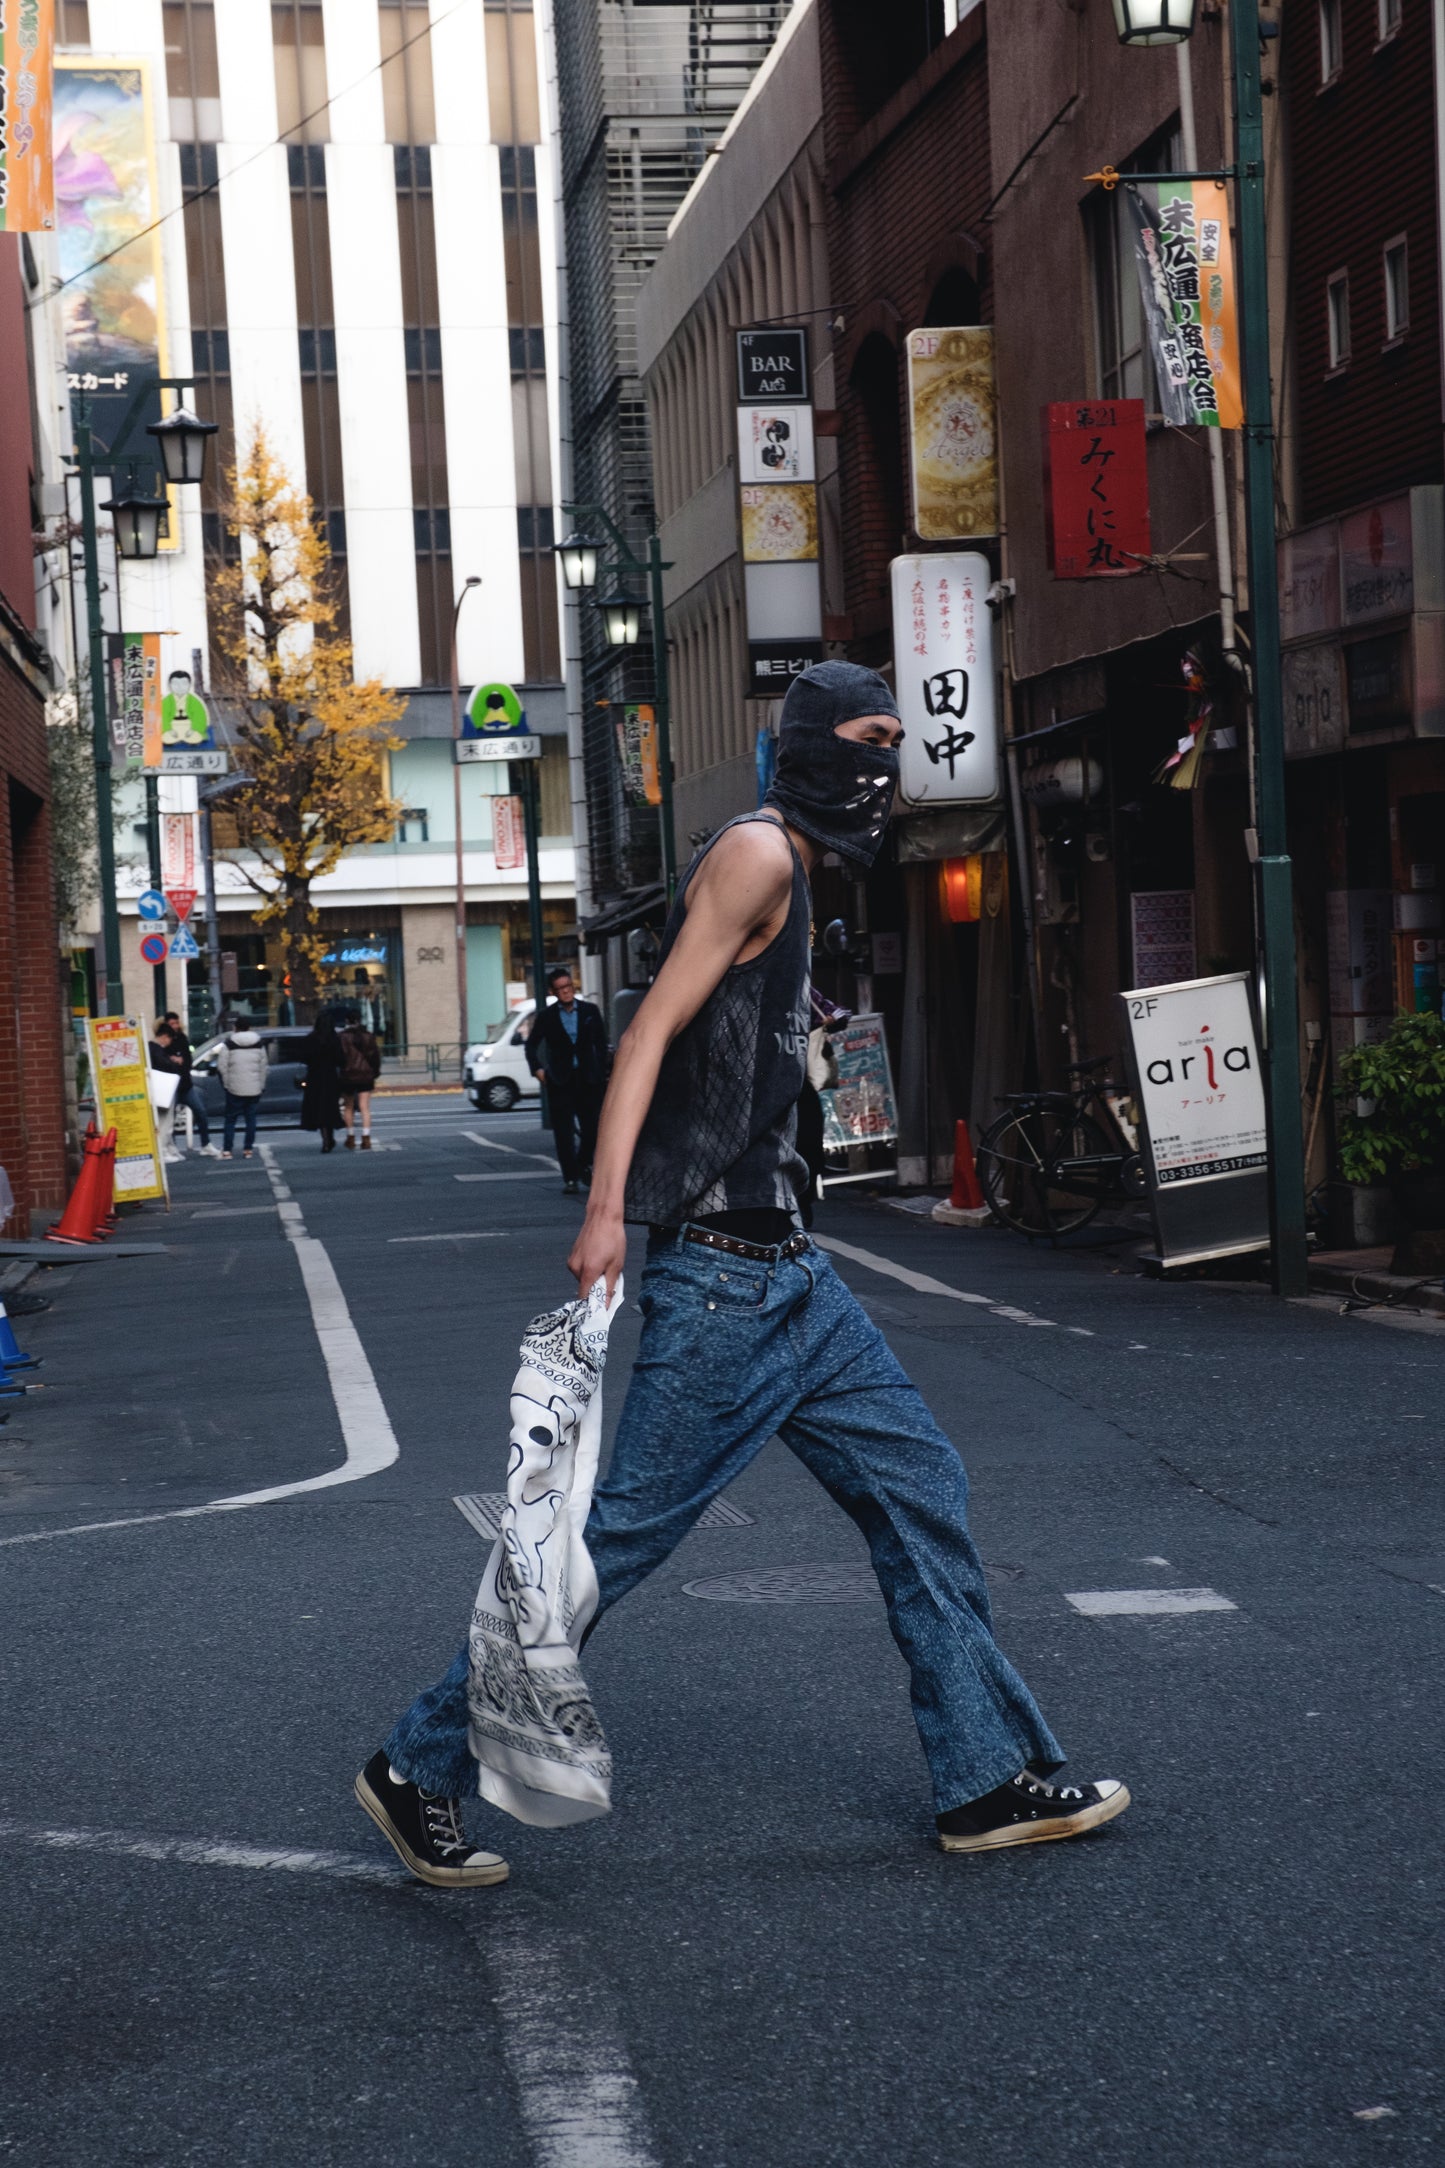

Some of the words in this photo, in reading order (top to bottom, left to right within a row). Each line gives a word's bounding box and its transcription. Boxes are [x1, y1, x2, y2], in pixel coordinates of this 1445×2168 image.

[1201, 223, 1217, 262] 安全
[1159, 197, 1218, 412] 末広通り商店会
[915, 337, 940, 355] 2F
[751, 356, 795, 373] BAR
[922, 438, 988, 466] Angel
[743, 490, 763, 505] 2F
[1080, 437, 1127, 568] みくに丸
[911, 580, 928, 656] 大阪伝統の味
[962, 577, 977, 665] 二度付け禁止の
[125, 643, 144, 757] 末広通り商店会
[922, 668, 975, 780] 田中
[166, 755, 221, 769] 広通り
[463, 741, 534, 757] 末広通り
[1131, 999, 1158, 1020] 2F
[1147, 1025, 1250, 1090] aria
[1181, 1093, 1226, 1109] アーリア
[1160, 1159, 1243, 1181] 03-3356-5517
